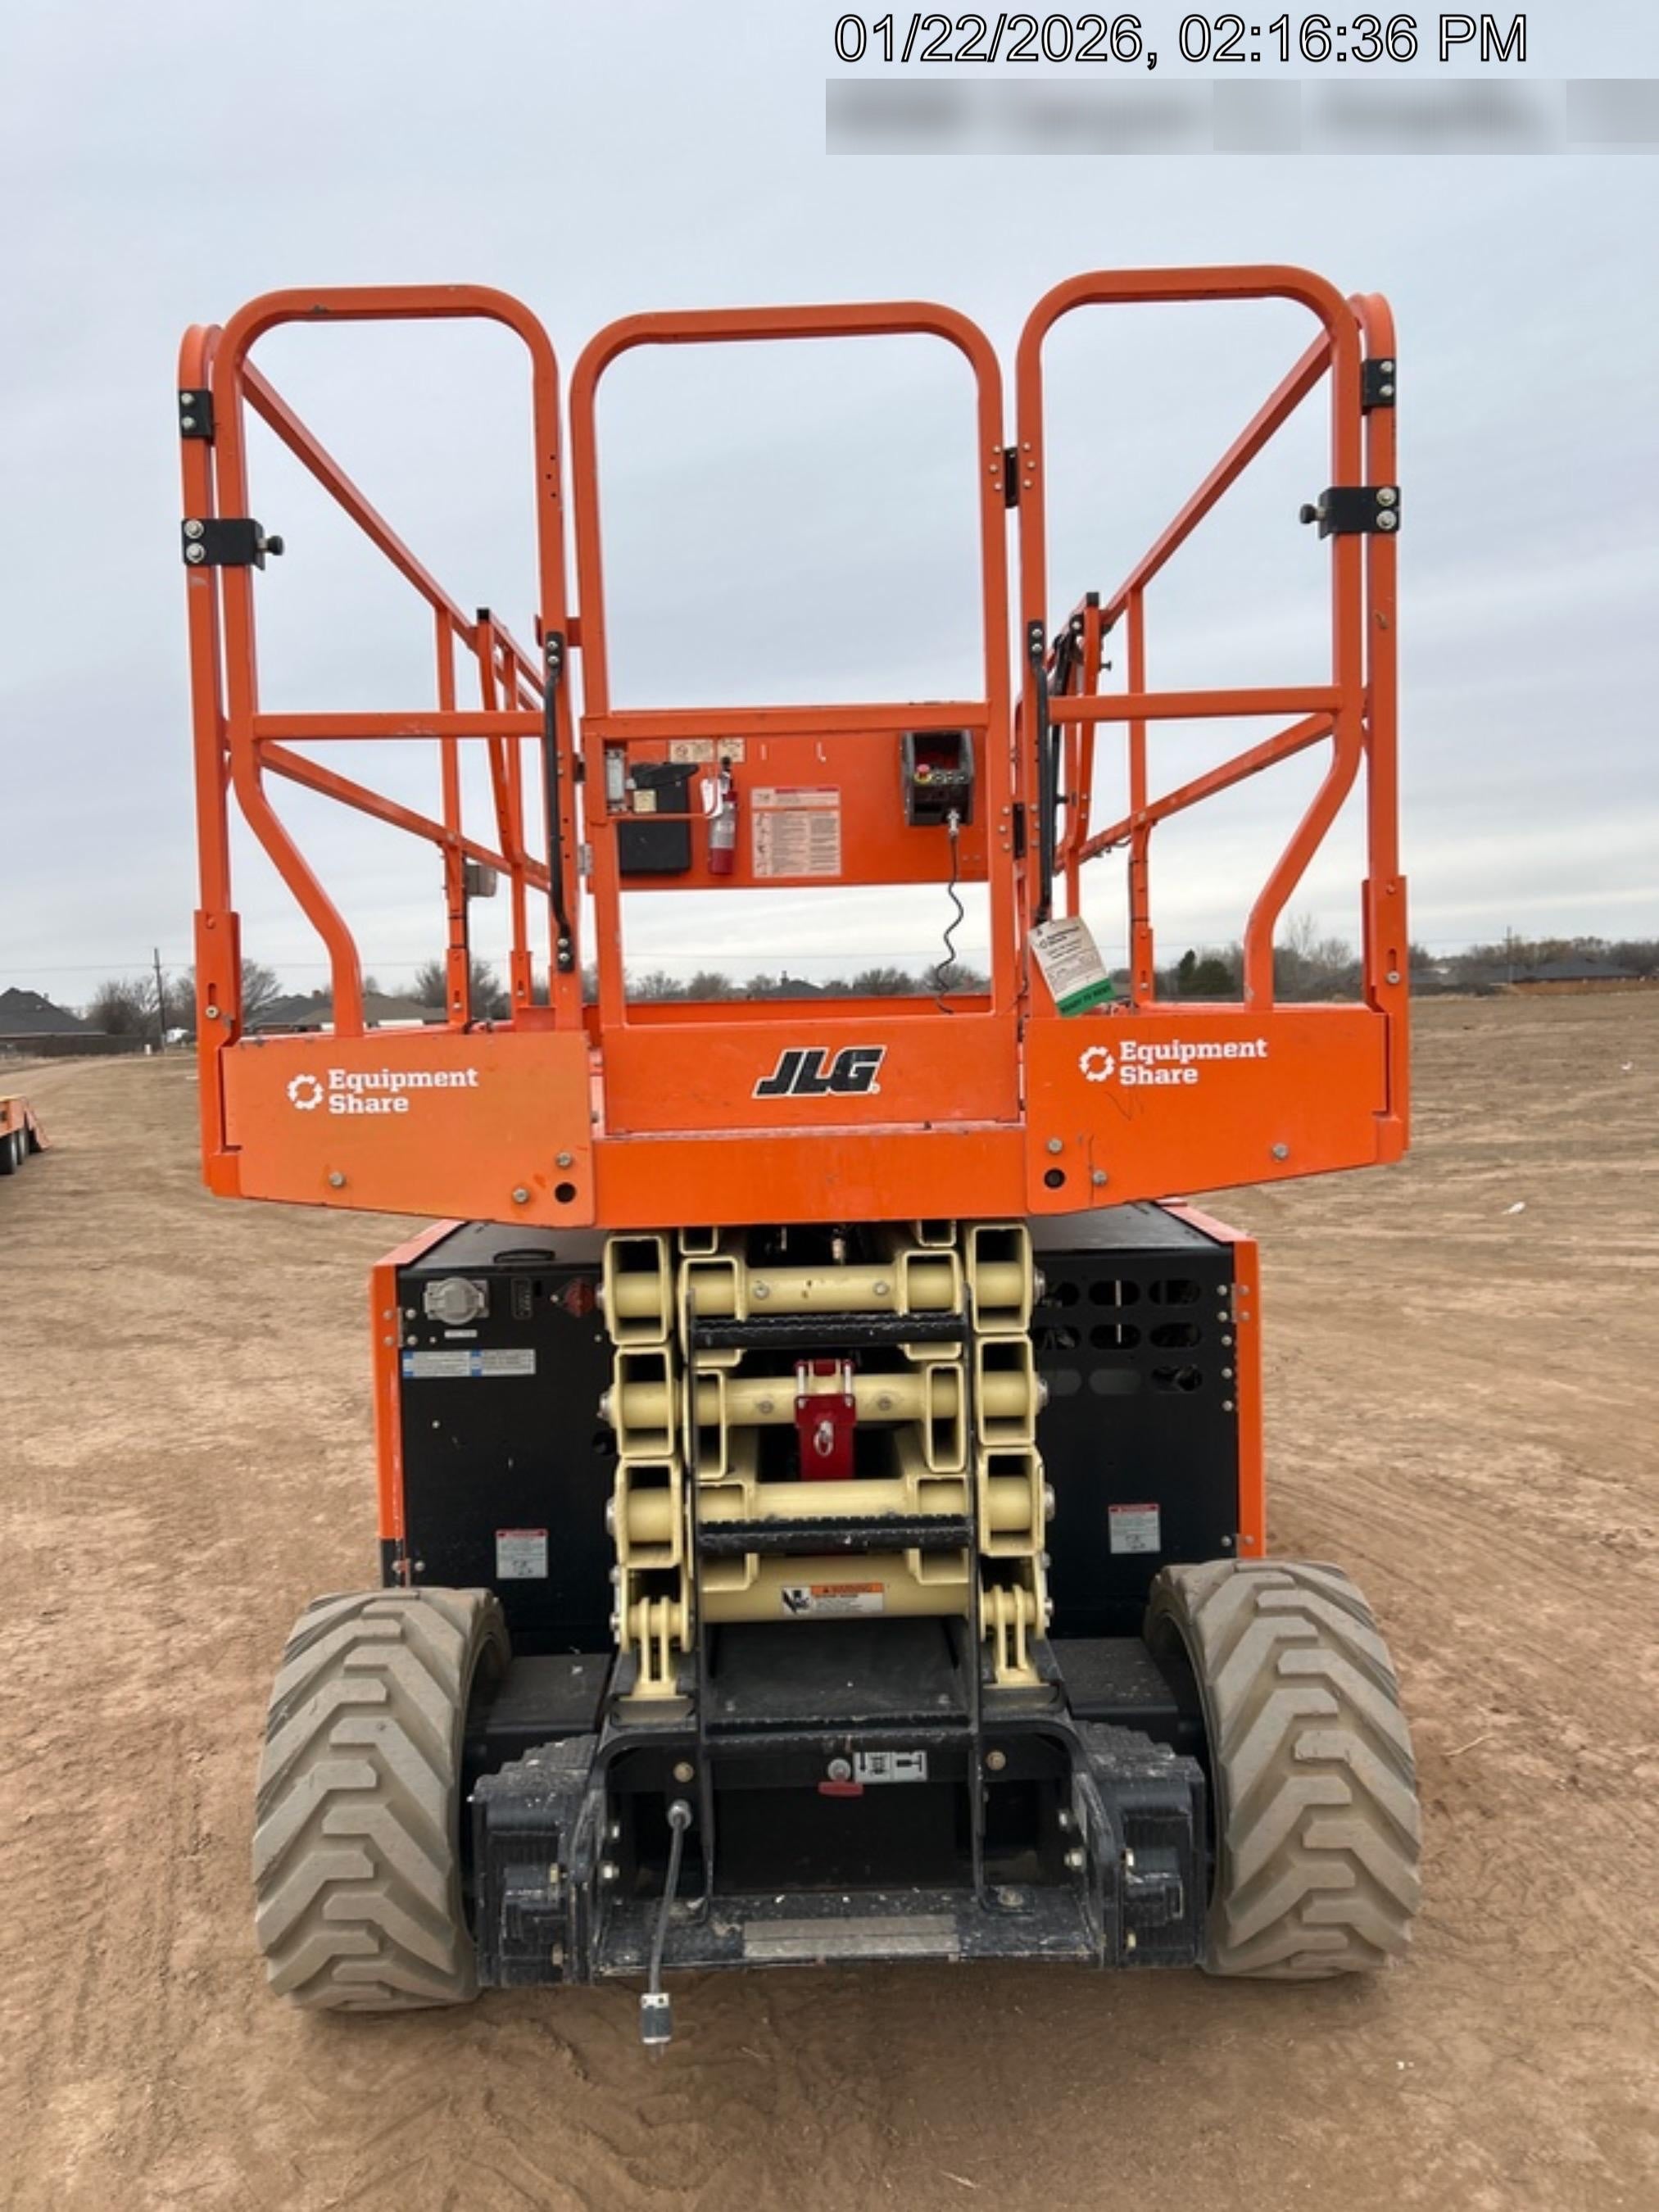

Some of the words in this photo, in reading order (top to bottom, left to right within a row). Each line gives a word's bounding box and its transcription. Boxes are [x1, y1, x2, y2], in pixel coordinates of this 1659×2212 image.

[1120, 1039, 1267, 1065] Equipment
[328, 1068, 478, 1094] Equipment
[752, 1045, 886, 1099] JLG
[1120, 1064, 1199, 1086] Share
[328, 1094, 409, 1114] Share
